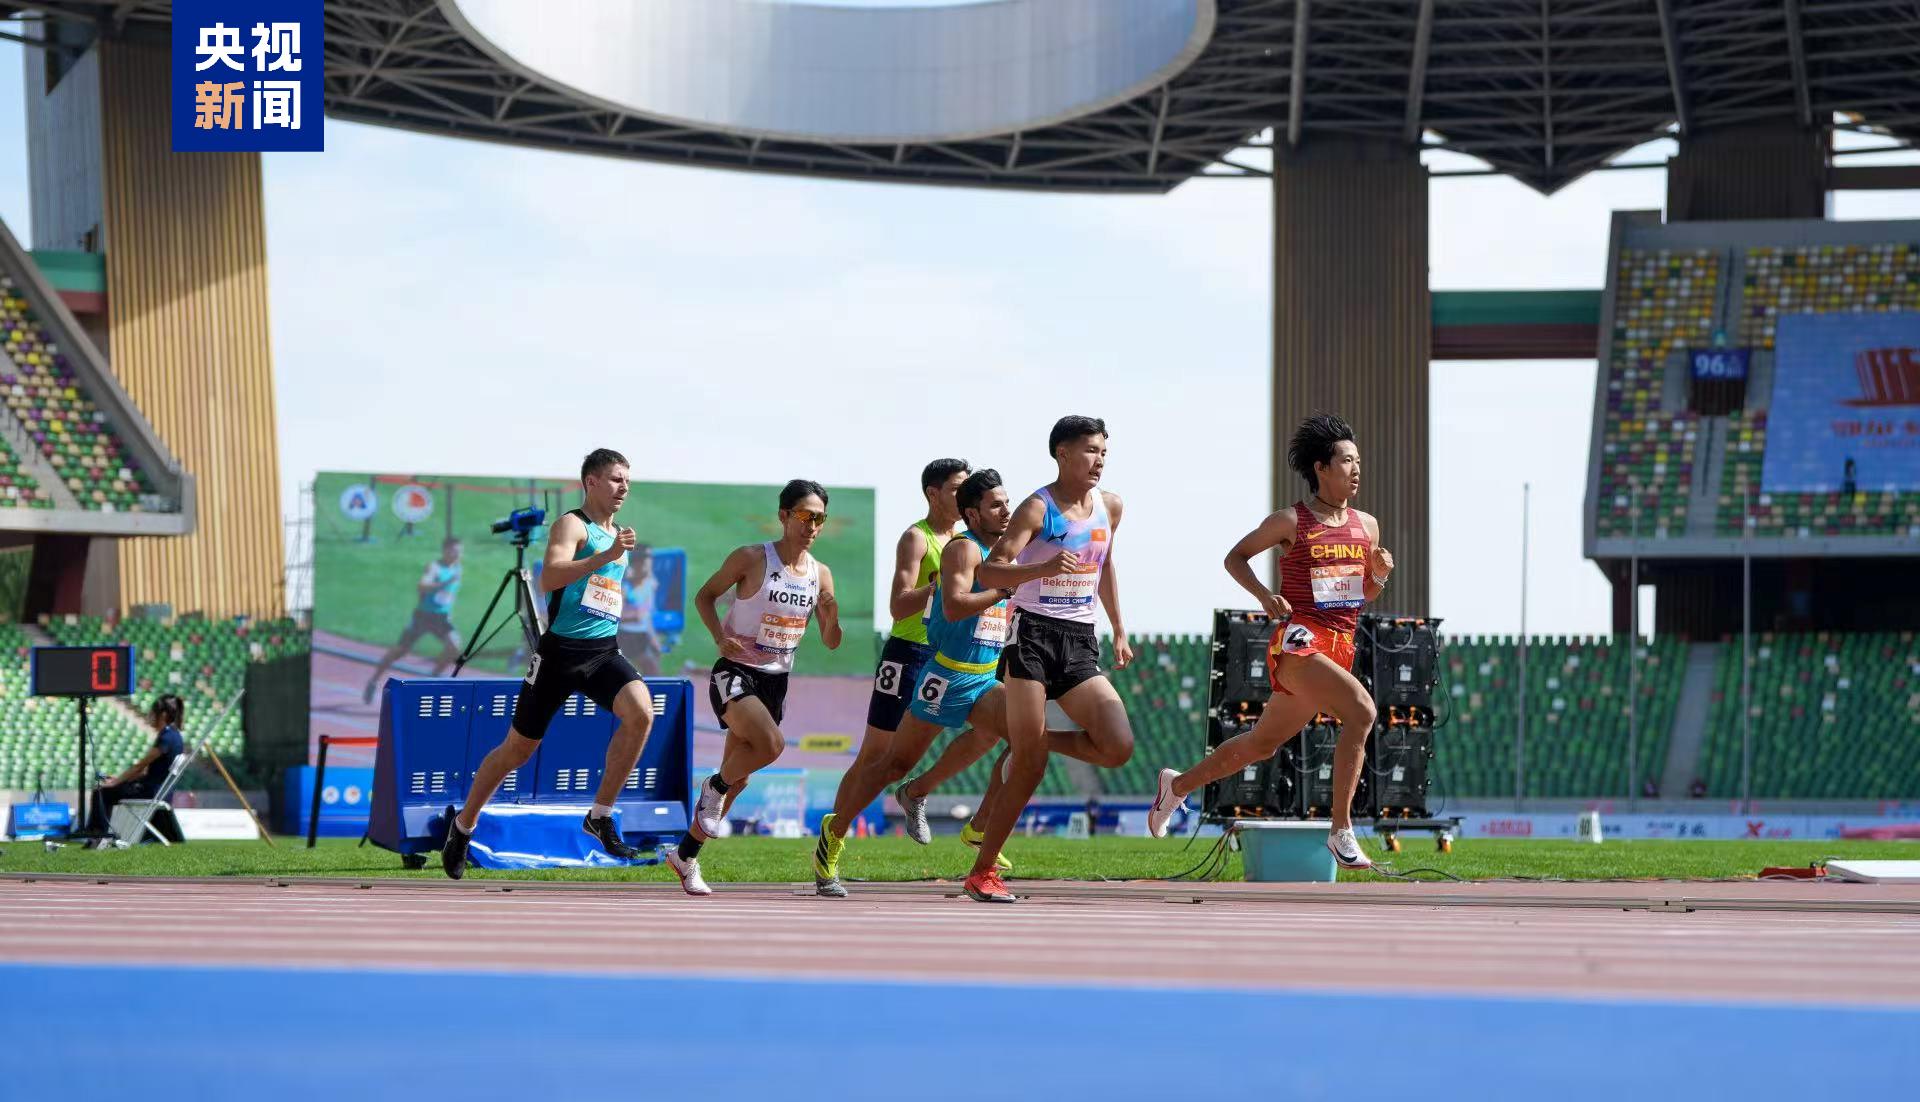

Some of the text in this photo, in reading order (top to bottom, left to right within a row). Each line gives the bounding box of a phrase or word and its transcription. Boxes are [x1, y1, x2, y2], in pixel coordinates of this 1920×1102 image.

[1695, 354, 1725, 377] 96
[1310, 544, 1364, 560] CHINA
[1334, 580, 1350, 591] Chi
[768, 589, 814, 608] KOREA
[91, 651, 117, 691] 0
[880, 665, 897, 691] 8
[921, 677, 942, 702] 6
